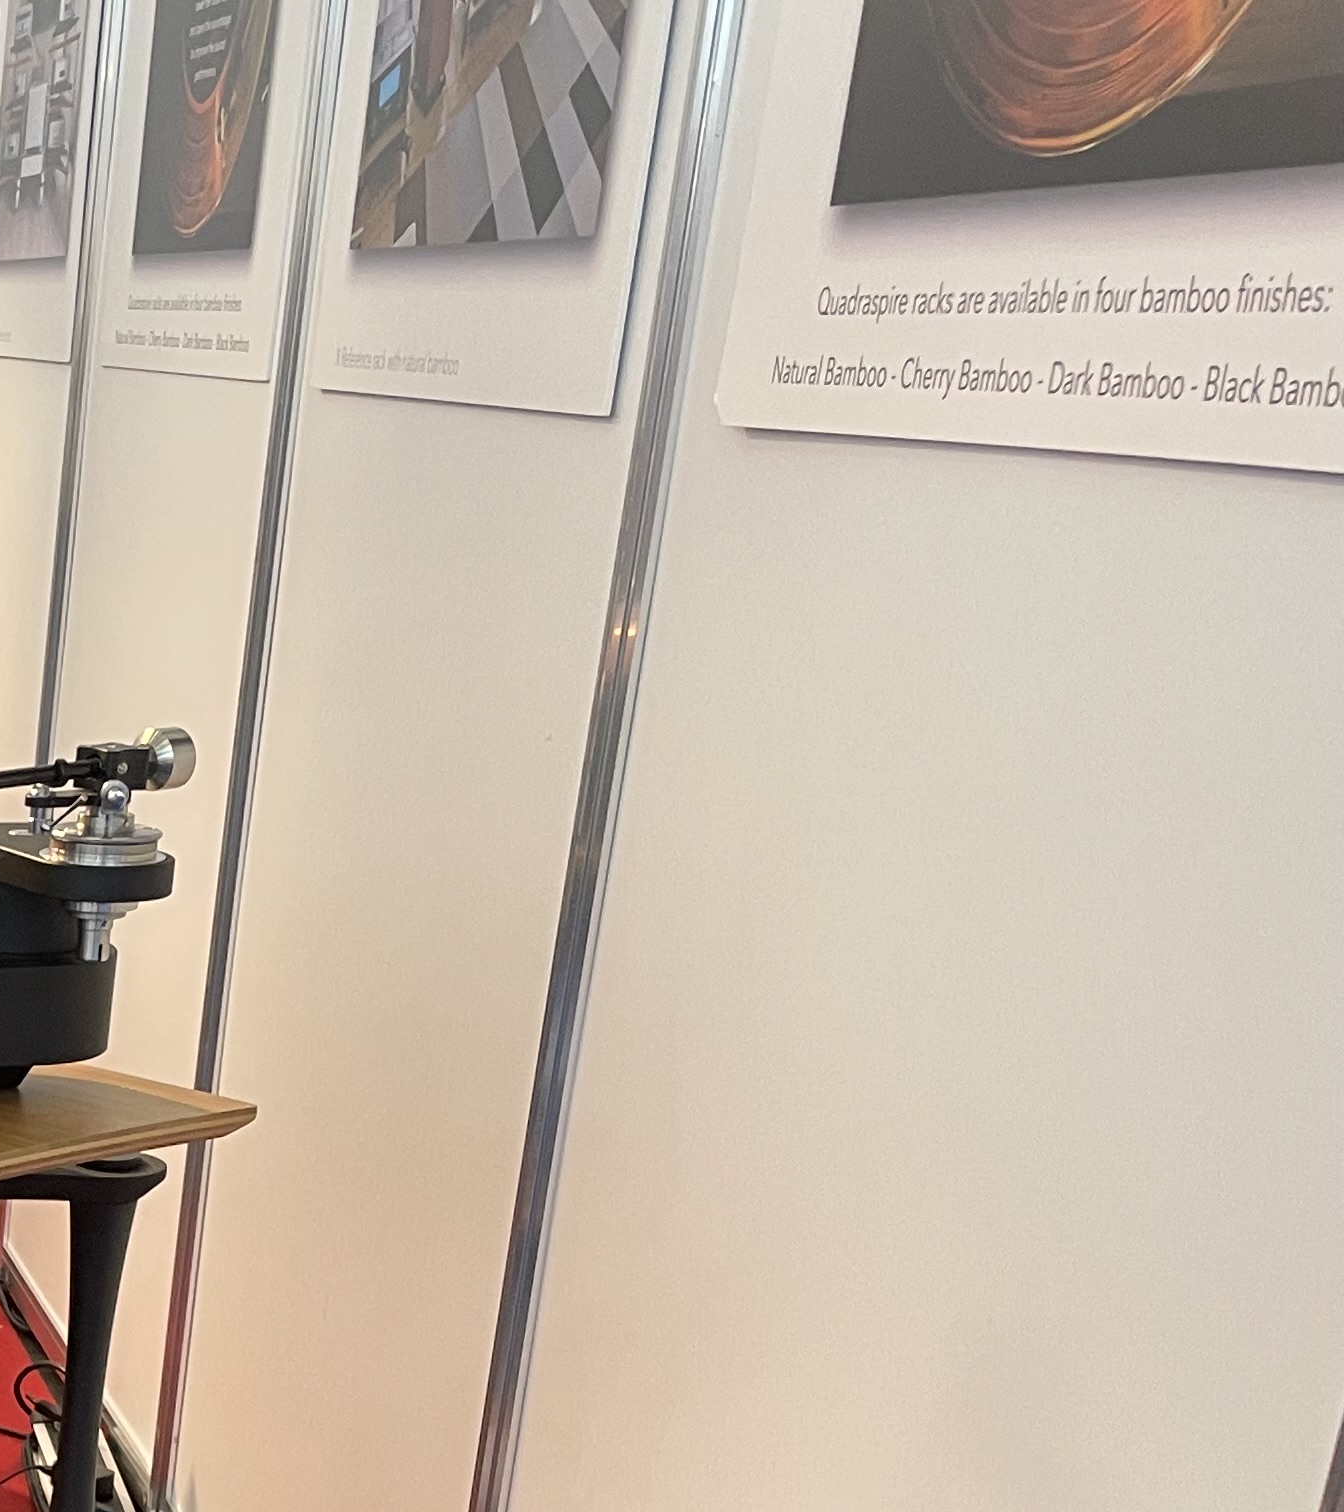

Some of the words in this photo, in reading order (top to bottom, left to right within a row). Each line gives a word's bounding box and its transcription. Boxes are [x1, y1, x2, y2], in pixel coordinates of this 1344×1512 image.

[817, 284, 907, 324] Quadraspire
[912, 286, 953, 316] racks
[956, 291, 983, 314] are
[987, 277, 1067, 315] available
[1072, 279, 1089, 313] in
[1092, 276, 1136, 318] four
[1138, 274, 1229, 314] bamboo
[1235, 271, 1333, 315] finishes:
[770, 355, 822, 386] Natural
[823, 359, 888, 388] Bamboo
[900, 358, 955, 400] Cherry
[958, 360, 1033, 394] Bamboo
[1047, 360, 1093, 396] Dark
[1096, 362, 1185, 401] Bamboo
[1202, 364, 1264, 404] Black
[1268, 366, 1344, 407] Bamb
